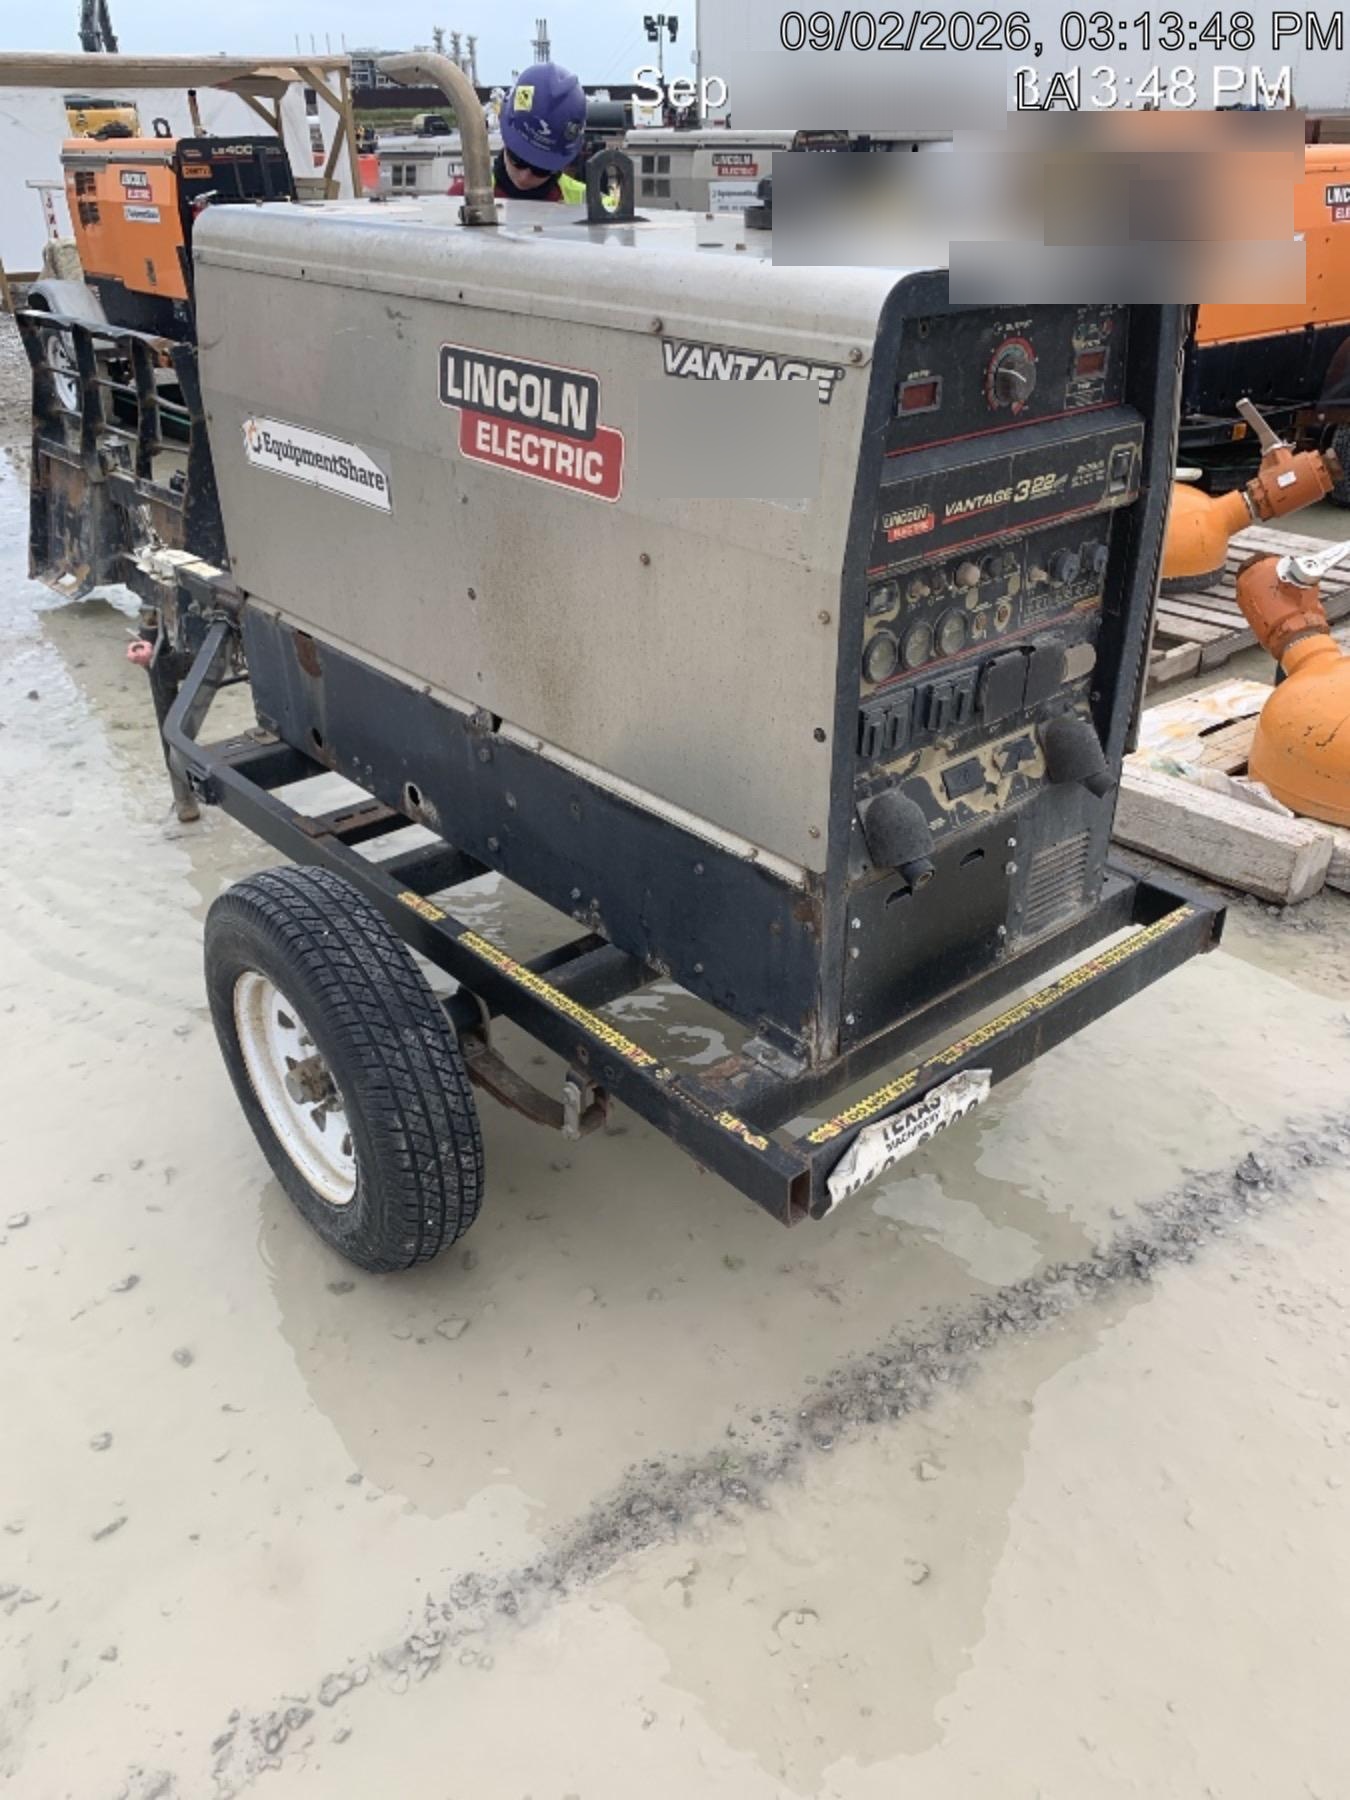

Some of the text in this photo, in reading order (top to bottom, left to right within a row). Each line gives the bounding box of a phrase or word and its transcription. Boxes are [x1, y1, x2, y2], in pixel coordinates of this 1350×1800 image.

[447, 356, 589, 431] LINCOLN
[263, 430, 385, 492] EquipmentShare
[476, 420, 604, 485] ELECTRIC
[944, 489, 1013, 517] VANTAGE
[1013, 474, 1057, 503] 322
